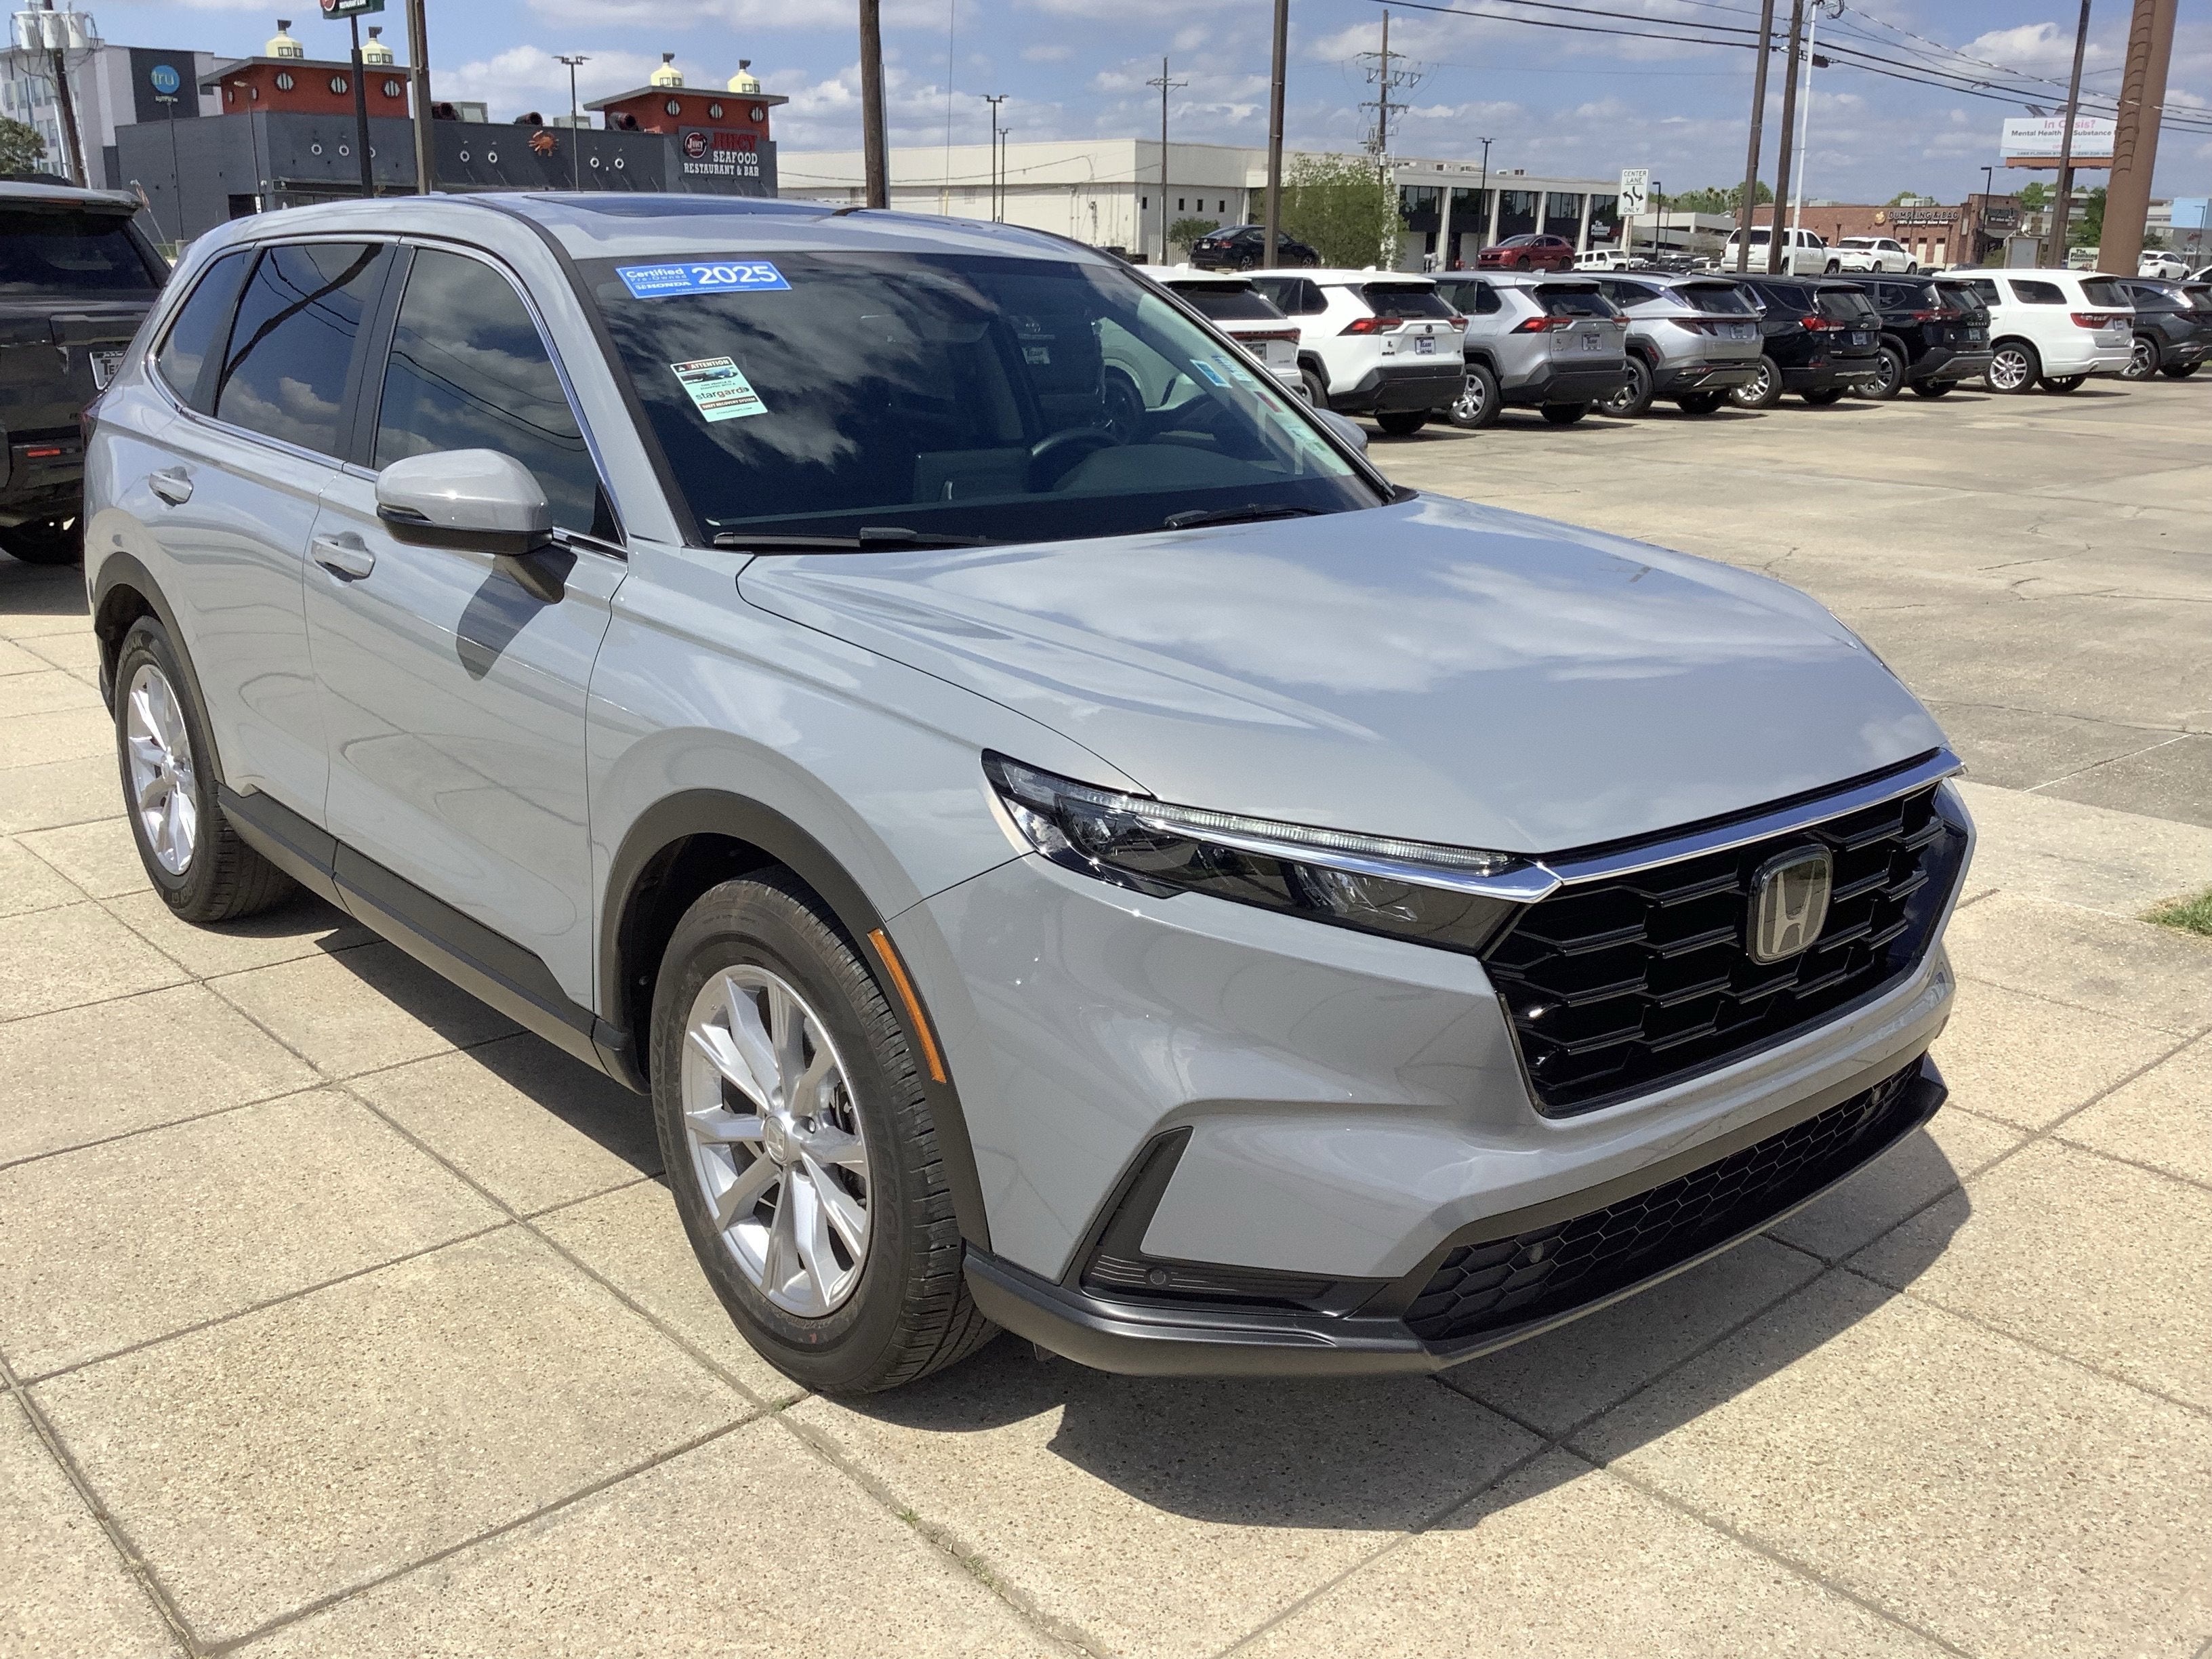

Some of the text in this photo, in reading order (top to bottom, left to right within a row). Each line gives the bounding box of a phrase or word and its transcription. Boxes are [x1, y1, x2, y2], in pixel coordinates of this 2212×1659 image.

[151, 70, 174, 86] tru
[2045, 119, 2096, 129] In Csis?
[713, 150, 758, 165] SEAFOOD
[684, 163, 760, 177] RESTAURANT & BAR
[626, 266, 779, 285] Certified 2025
[630, 274, 687, 282] Pre-Owned
[691, 359, 730, 370] ATTENTION
